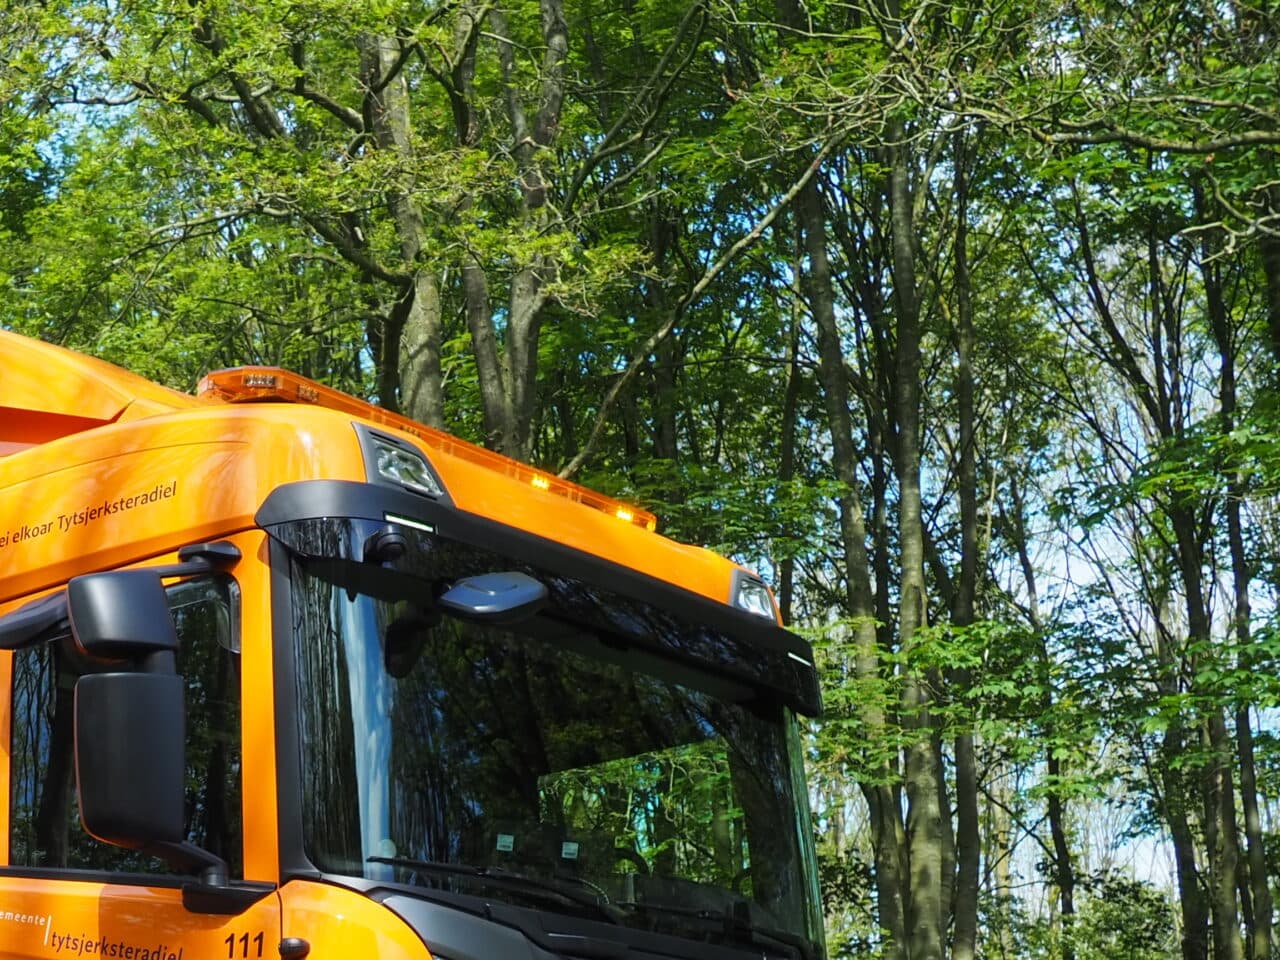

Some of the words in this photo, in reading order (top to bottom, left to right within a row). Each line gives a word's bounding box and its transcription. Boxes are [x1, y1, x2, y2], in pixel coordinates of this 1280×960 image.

[11, 519, 55, 544] elkoar
[57, 480, 178, 530] Tytsjerksteradiel
[224, 931, 265, 959] 111
